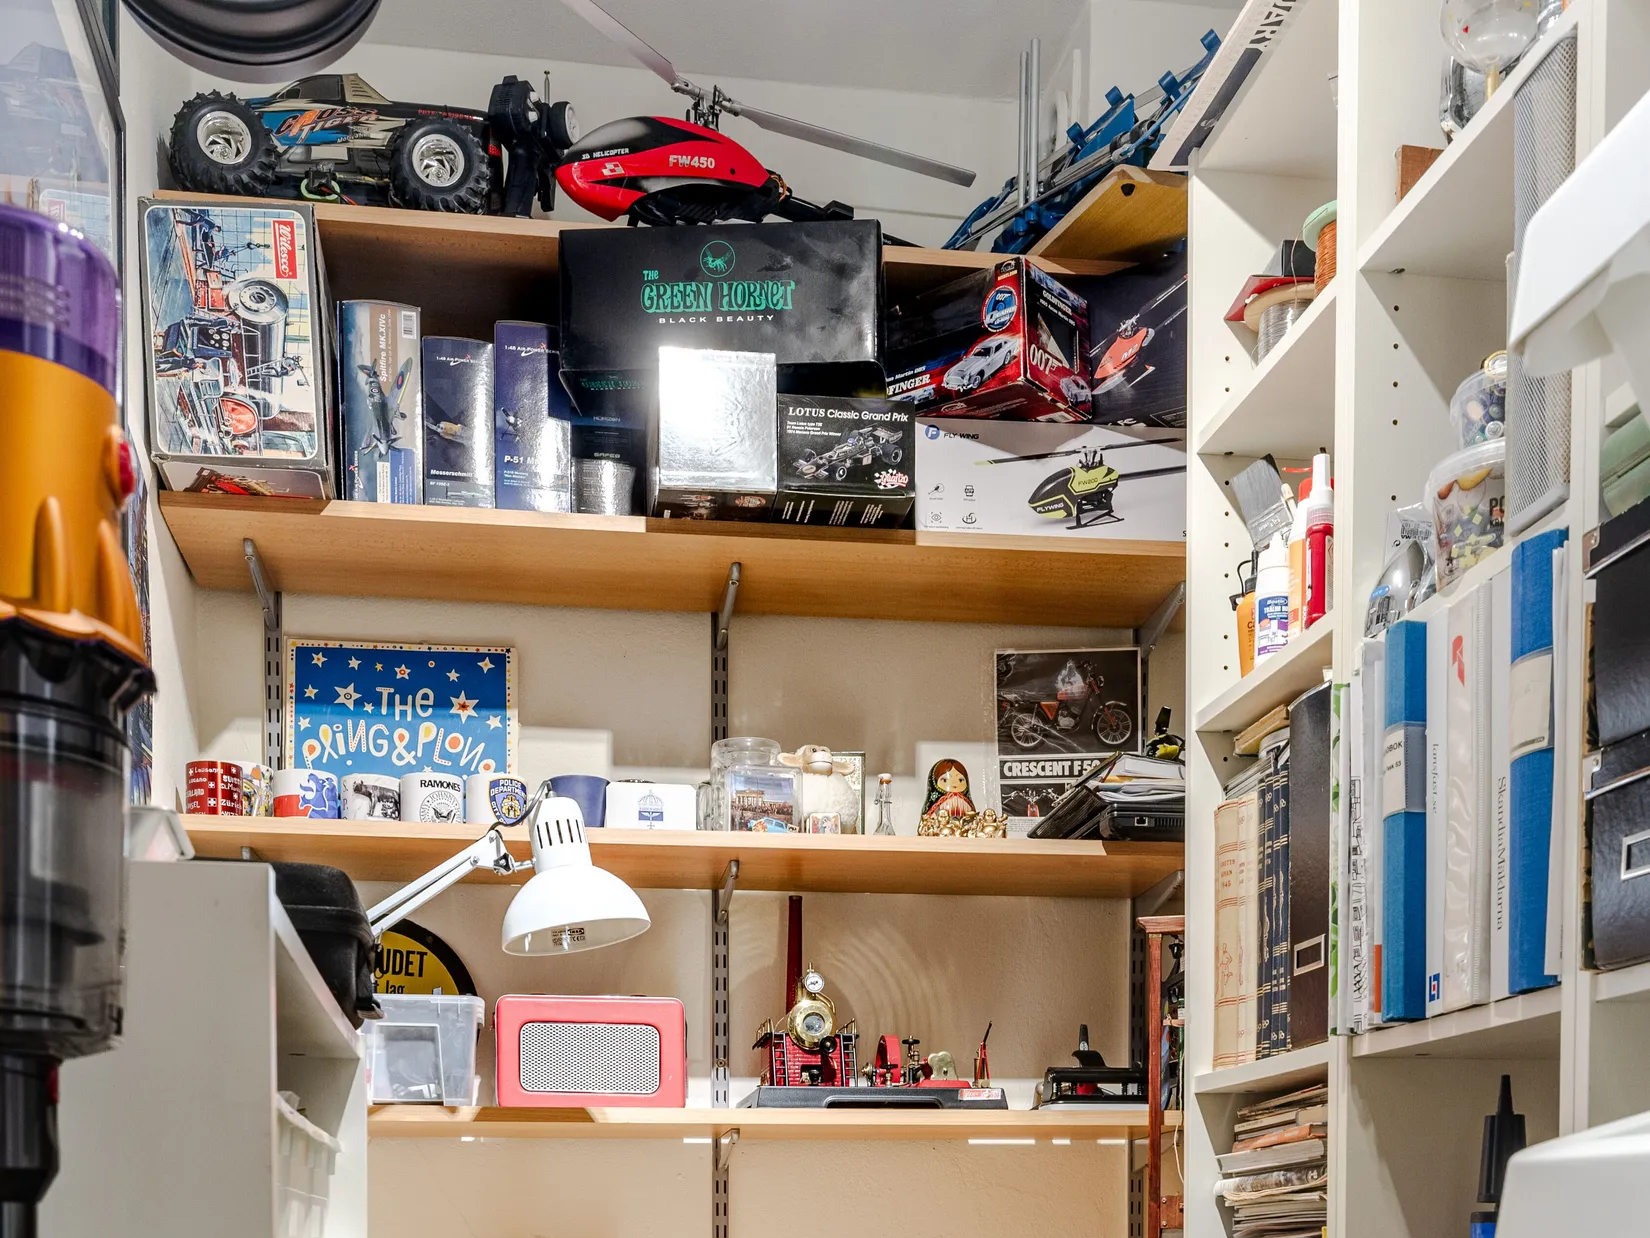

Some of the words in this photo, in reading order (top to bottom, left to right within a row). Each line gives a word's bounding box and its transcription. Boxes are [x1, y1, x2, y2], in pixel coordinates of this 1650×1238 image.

[593, 148, 630, 159] HELICOPTER
[668, 155, 716, 169] FW450
[275, 222, 292, 277] Wilesco
[641, 282, 713, 313] GREEN
[716, 315, 775, 323] BEAUTY
[1030, 344, 1062, 374] 007
[379, 352, 387, 382] Spitfire
[887, 374, 931, 396] FINGER
[788, 407, 825, 418] LOTUS
[827, 409, 859, 420] Classic
[861, 411, 890, 421] Grand
[892, 413, 909, 422] Prix
[1036, 502, 1064, 513] FLYWING
[1003, 761, 1071, 777] CRESCENT
[420, 779, 462, 793] RAMONES
[499, 779, 522, 789] POLICE
[1496, 776, 1507, 931] SkandiaMäklarna
